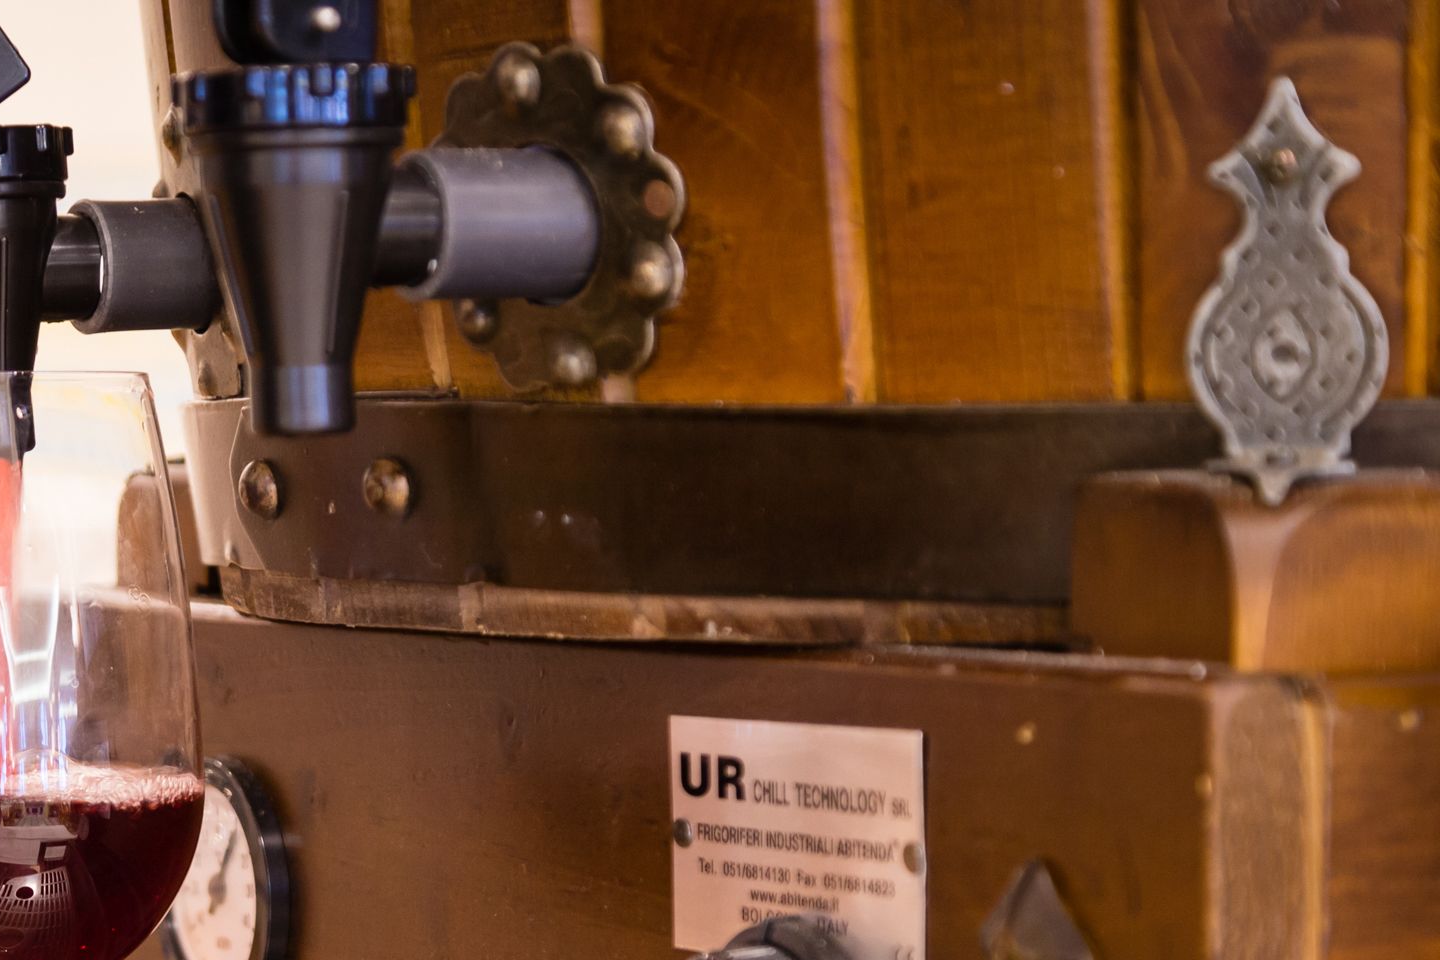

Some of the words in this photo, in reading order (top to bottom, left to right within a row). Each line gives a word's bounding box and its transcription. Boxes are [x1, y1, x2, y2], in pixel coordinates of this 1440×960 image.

[680, 751, 746, 801] UR
[753, 779, 790, 806] CHILL
[794, 781, 886, 815] TECHNOLOGY
[697, 822, 764, 849] FRIGORIFERI
[766, 829, 834, 856] INDUSTRIALI
[698, 856, 717, 875] Tel.
[723, 861, 791, 884] 051/6814130
[797, 868, 816, 888] Fax
